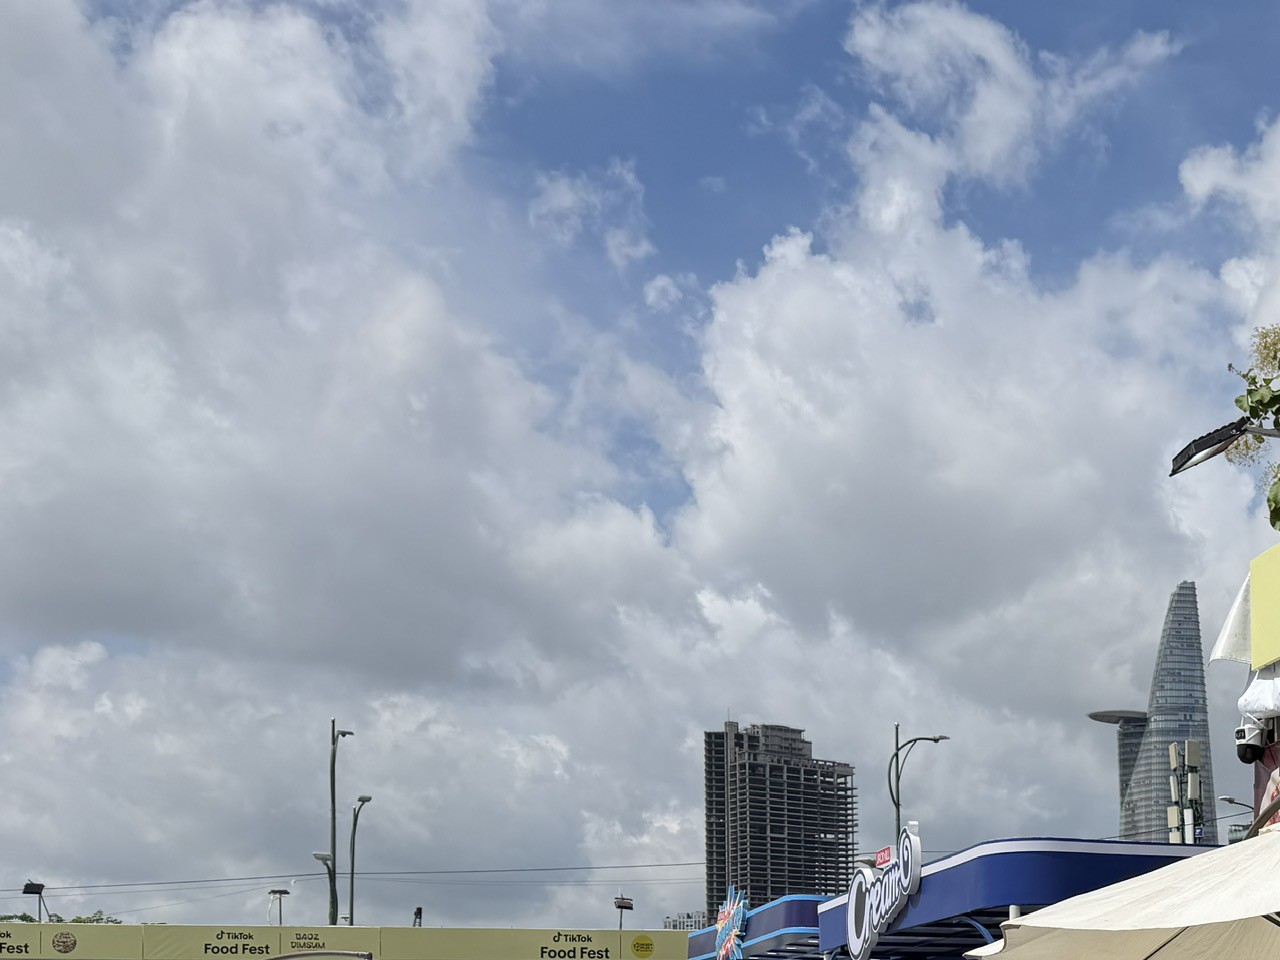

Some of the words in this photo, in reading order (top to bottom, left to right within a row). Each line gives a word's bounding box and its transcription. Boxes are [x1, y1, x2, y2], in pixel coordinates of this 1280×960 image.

[226, 932, 254, 940] TikTok
[563, 934, 593, 943] TikTok
[203, 943, 239, 955] Food
[241, 943, 271, 955] Fest
[540, 946, 577, 959] Food
[579, 946, 610, 959] Fest
